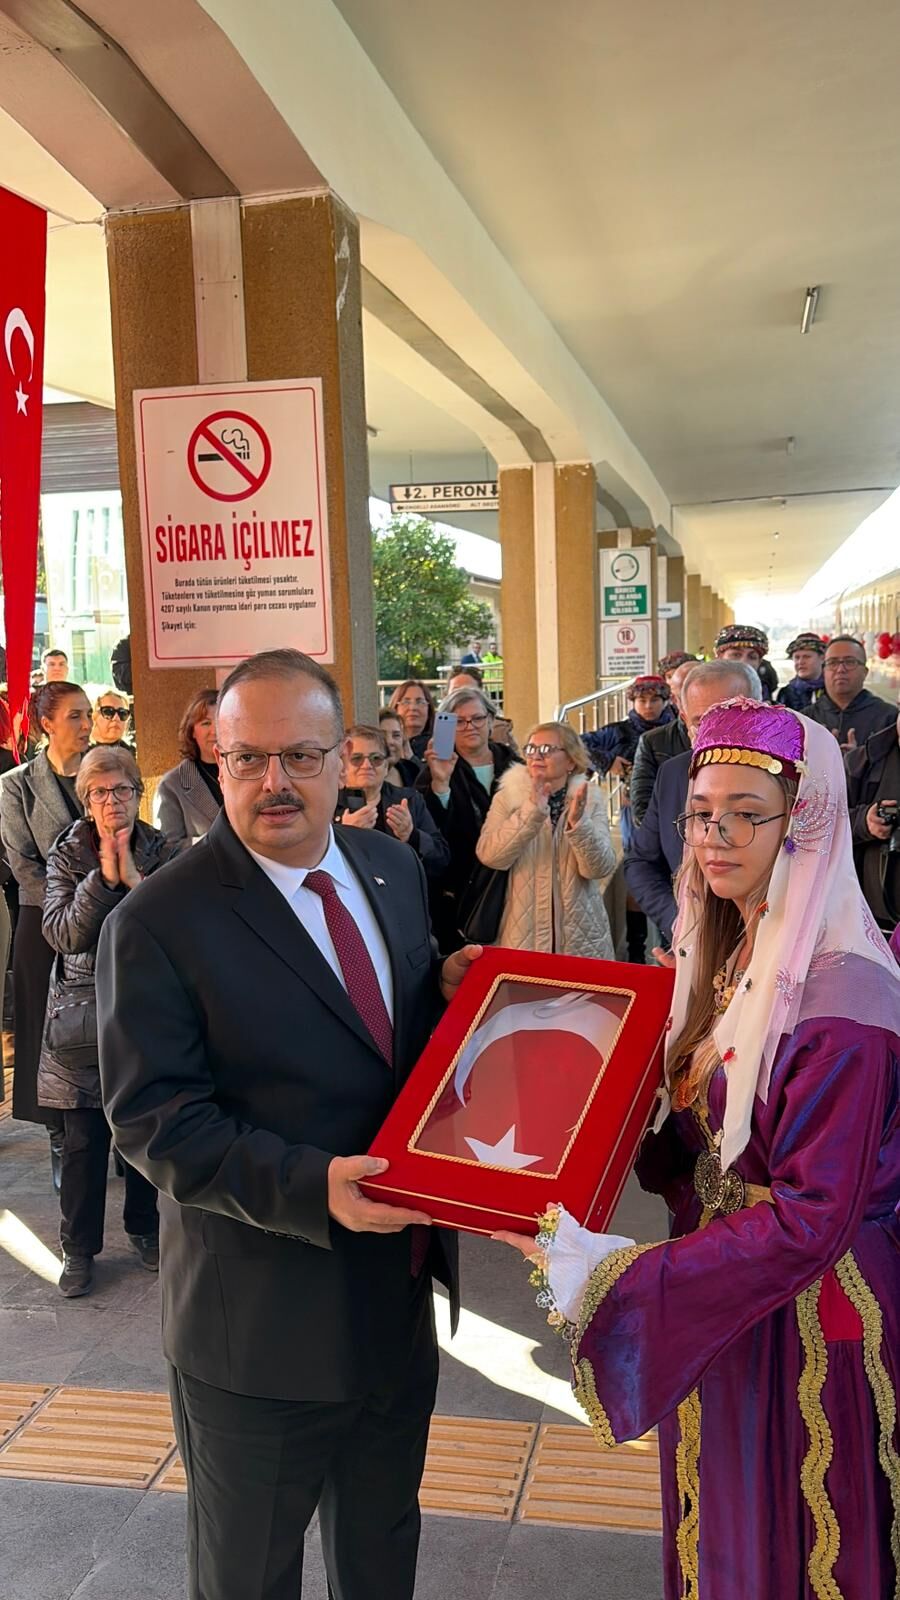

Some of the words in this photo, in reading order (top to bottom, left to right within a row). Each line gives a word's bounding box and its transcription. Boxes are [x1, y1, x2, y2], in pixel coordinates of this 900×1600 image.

[413, 487, 427, 499] 2.
[433, 485, 487, 498] PERON
[155, 514, 227, 564] SİGARA
[232, 510, 315, 571] İÇİLMEZ
[175, 578, 195, 587] Burada
[197, 577, 212, 586] tütün
[213, 576, 237, 586] ürünleri
[238, 575, 272, 585] tüketilmesi
[273, 574, 299, 585] yasaktır.
[162, 591, 195, 600] Tüketenlere
[205, 589, 244, 599] tüketilmesine
[246, 588, 256, 599] göz
[257, 589, 276, 599] yuman
[278, 587, 314, 596] sorumlulara
[161, 604, 174, 613] 4207
[176, 603, 192, 614] sayılı
[193, 603, 211, 612] Kanun
[212, 603, 237, 613] uyarınca
[254, 602, 267, 612] para
[268, 601, 287, 610] cezası
[289, 600, 317, 611] uygulanır
[161, 621, 182, 632] Şikayet
